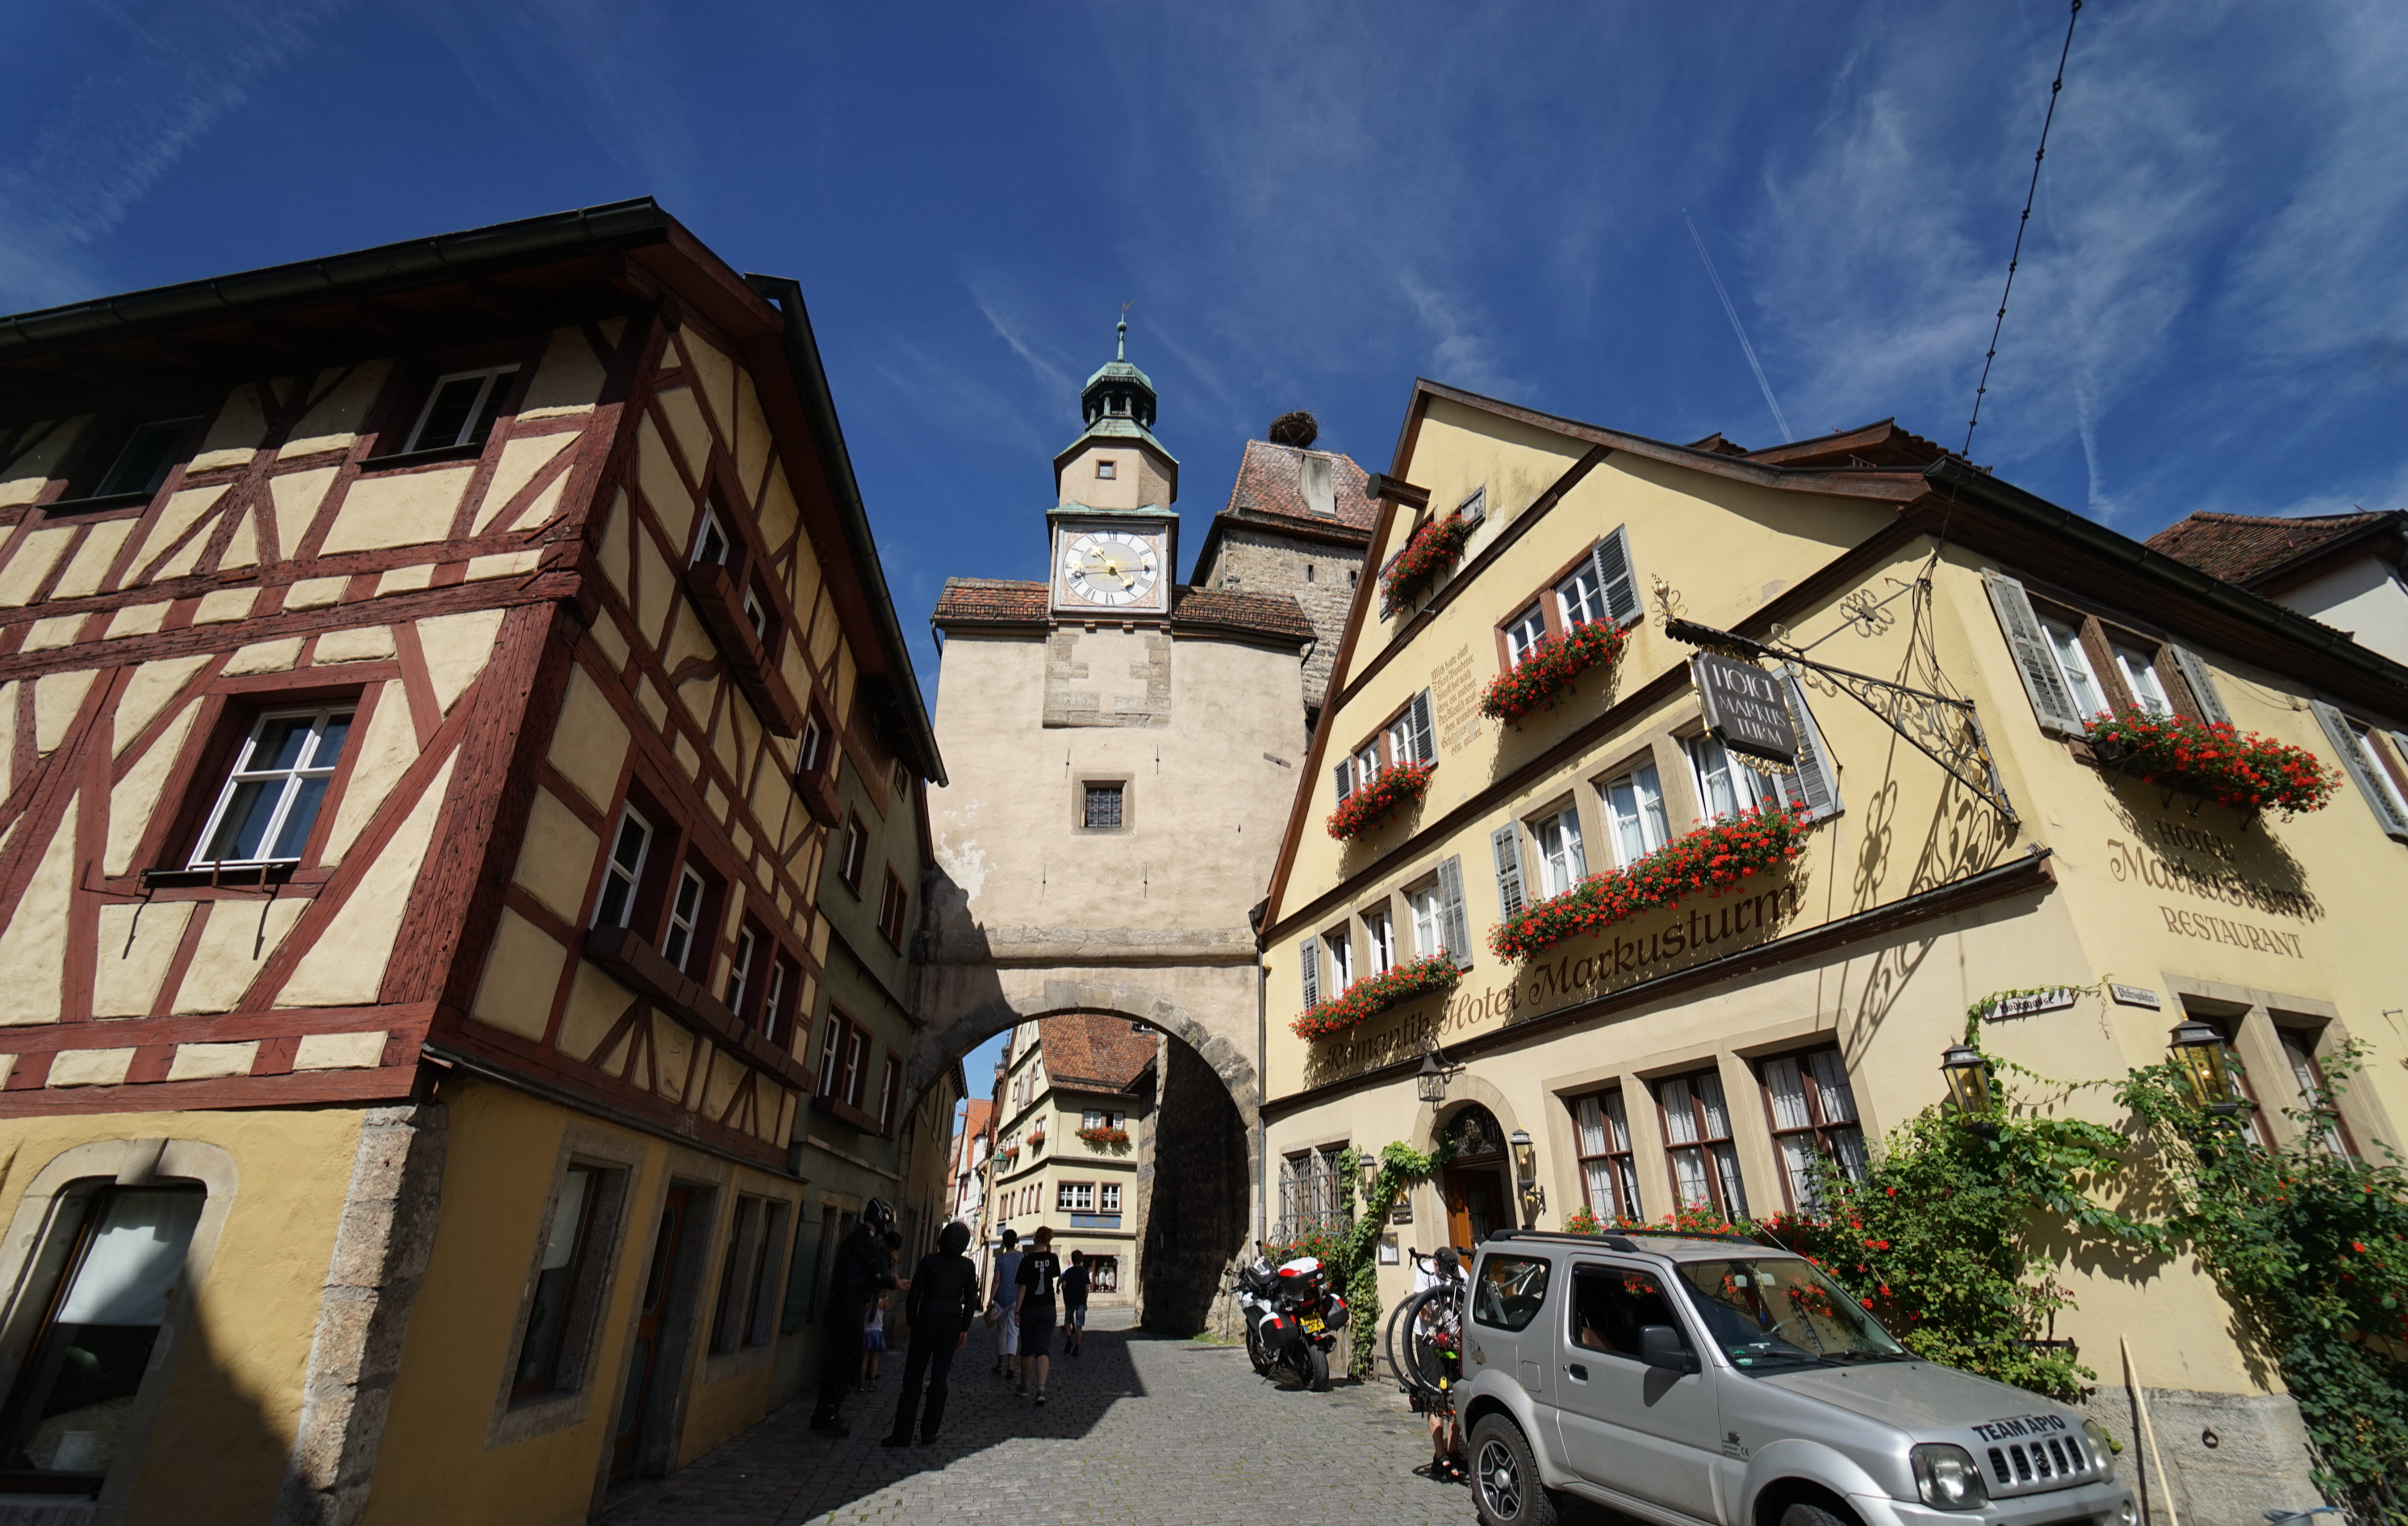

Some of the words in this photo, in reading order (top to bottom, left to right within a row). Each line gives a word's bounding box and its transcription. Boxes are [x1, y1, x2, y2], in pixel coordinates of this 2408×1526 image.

[1719, 695, 1786, 728] MARKUS
[1734, 717, 1783, 746] TURM
[2154, 820, 2235, 863] HOTEL
[2107, 838, 2316, 923] Markusturm
[2158, 905, 2305, 959] RESTAURANT
[1323, 1010, 1431, 1076] Romantik
[1440, 980, 1522, 1036] Hotel
[1528, 882, 1806, 1005] Markusturm
[1035, 1259, 1050, 1268] EXO
[1971, 1419, 2030, 1442] TEAM
[2024, 1414, 2067, 1434] APIO
